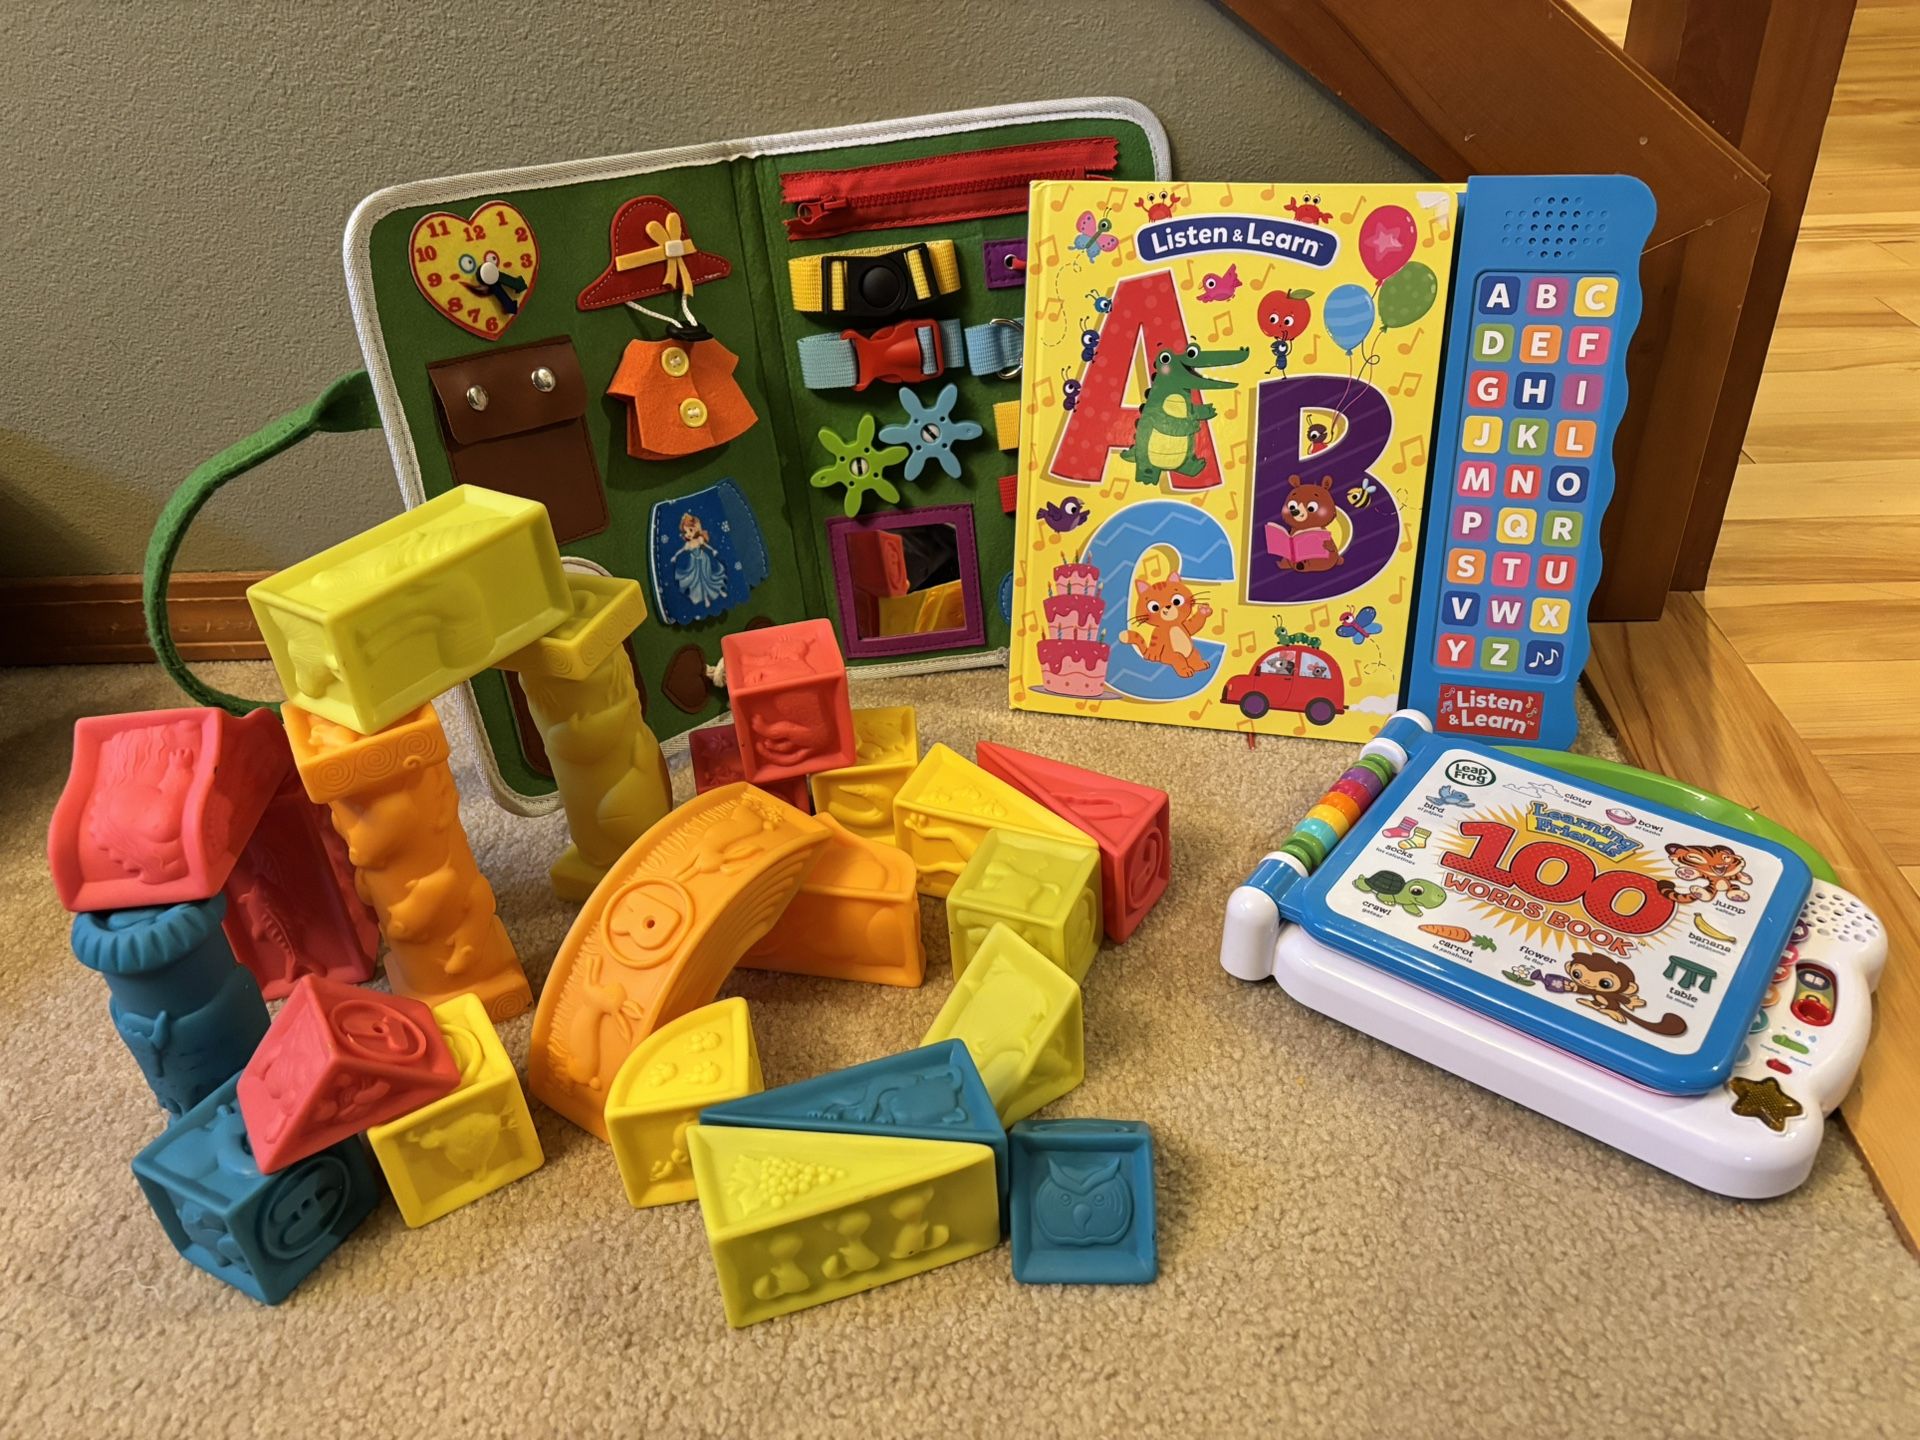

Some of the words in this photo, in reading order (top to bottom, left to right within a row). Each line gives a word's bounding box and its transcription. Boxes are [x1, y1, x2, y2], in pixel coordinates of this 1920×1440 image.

[496, 211, 508, 226] 1
[427, 220, 450, 238] 11
[464, 225, 486, 242] 12
[515, 227, 528, 242] 2
[1151, 226, 1228, 254] Listen
[1232, 229, 1243, 242] &
[1246, 223, 1318, 258] Learn
[416, 246, 436, 262] 10
[520, 253, 532, 268] 3
[427, 273, 442, 287] 9
[448, 297, 463, 312] 8
[1486, 283, 1510, 308] A
[1536, 284, 1556, 309] B
[1584, 284, 1608, 311] C
[468, 308, 480, 323] 7
[486, 317, 498, 332] 6
[1482, 330, 1504, 355] D
[1530, 332, 1552, 357] E
[1578, 333, 1599, 358] F
[1050, 270, 1223, 490] A
[1477, 377, 1499, 401] G
[1522, 378, 1547, 404] H
[1576, 380, 1587, 405] I
[1473, 423, 1490, 447] J
[1517, 424, 1539, 448] K
[1566, 427, 1583, 451] L
[1247, 376, 1401, 604] B
[1462, 468, 1490, 491] M
[1510, 469, 1534, 494] N
[1556, 472, 1581, 496] O
[1462, 511, 1482, 534] P
[1504, 514, 1528, 538] Q
[1551, 517, 1573, 541] R
[1456, 555, 1475, 578] S
[1502, 558, 1522, 581] T
[1545, 561, 1568, 585] U
[1081, 501, 1236, 700] C
[1452, 597, 1472, 620] V
[1490, 600, 1521, 624] W
[1539, 604, 1561, 627] X
[1446, 639, 1467, 662] Y
[1490, 643, 1510, 666] Z
[1457, 690, 1523, 712] Listen
[1449, 714, 1459, 725] &
[1462, 709, 1526, 734] Learn
[1454, 771, 1486, 784] Frog
[1456, 764, 1487, 775] Leap
[1424, 802, 1445, 813] bird
[1564, 792, 1592, 805] cloud
[1533, 802, 1639, 852] Learning
[1638, 820, 1664, 832] bowl
[1535, 817, 1622, 857] Friends
[1385, 845, 1413, 858] socks
[1440, 821, 1676, 934] 100
[1362, 901, 1391, 915] crawl
[1443, 872, 1544, 919] WORDS
[1547, 911, 1634, 956] BOOK
[1713, 900, 1746, 915] jump
[1439, 940, 1474, 957] carrot
[1688, 932, 1731, 953] banana
[1520, 945, 1556, 964] flower
[1669, 987, 1698, 1003] table
